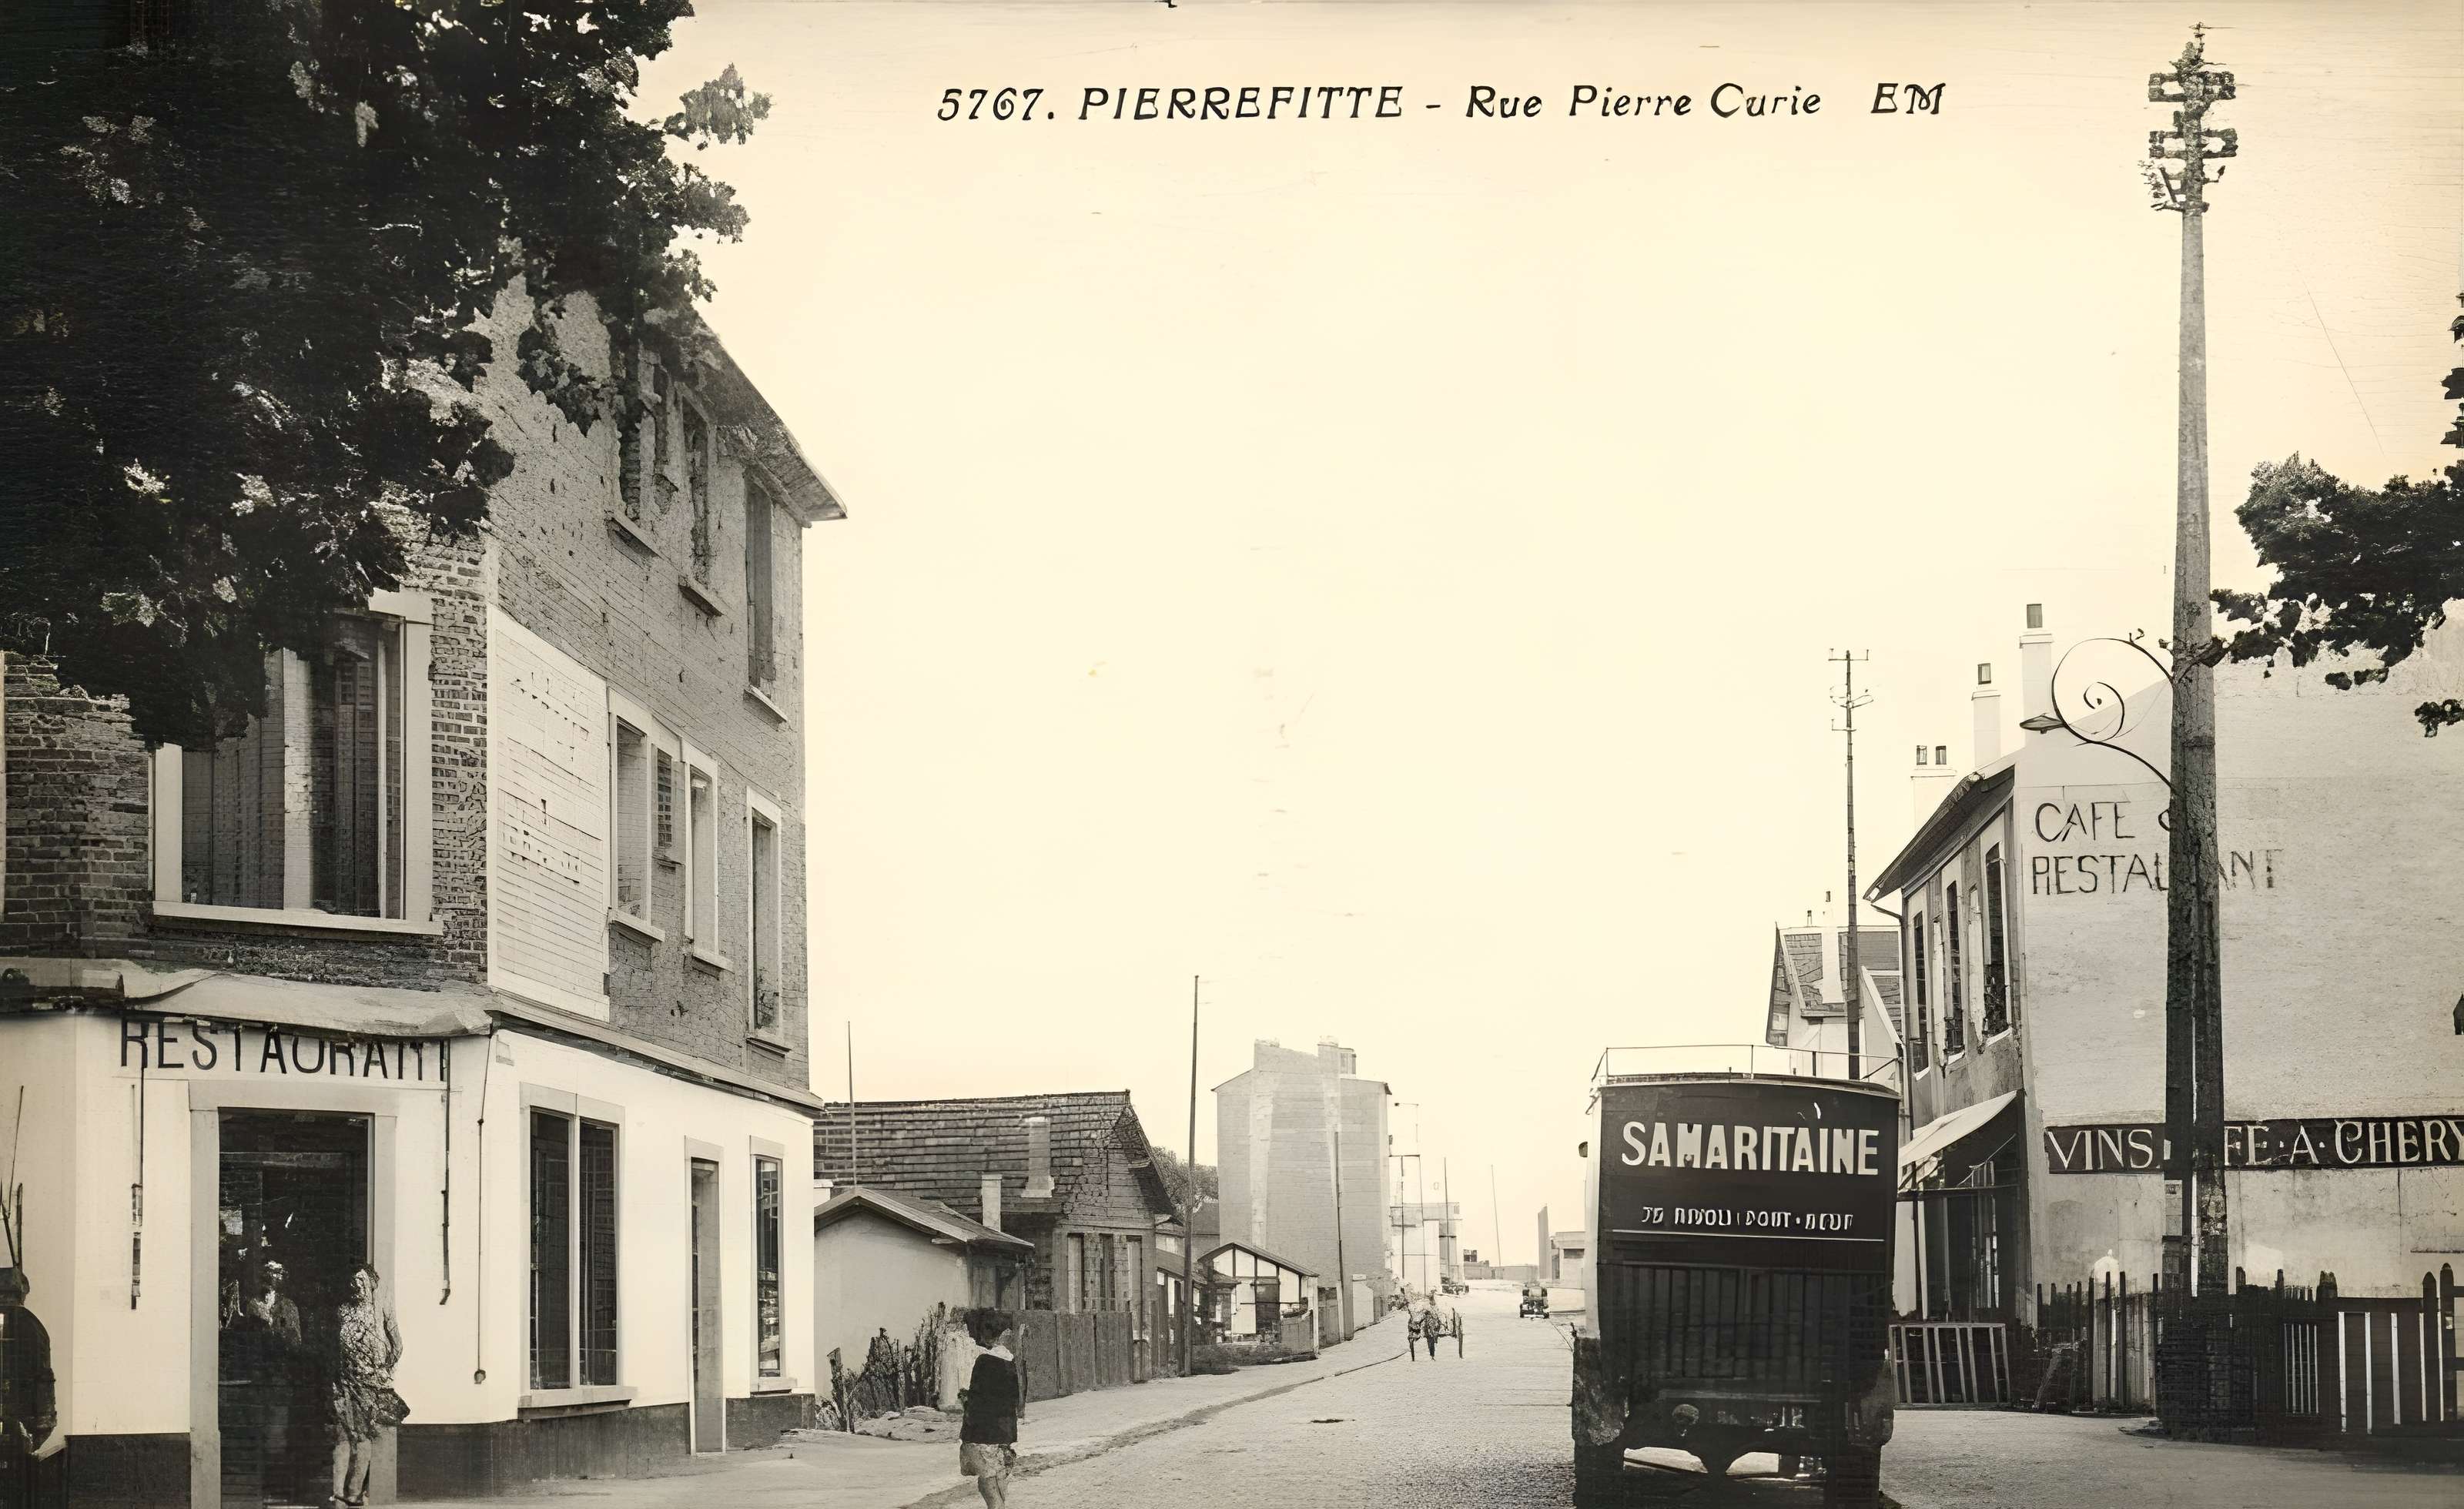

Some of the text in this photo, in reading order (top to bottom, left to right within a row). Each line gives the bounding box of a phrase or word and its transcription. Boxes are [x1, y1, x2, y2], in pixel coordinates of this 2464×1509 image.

[2032, 849, 2284, 895] RESTAUNT
[1622, 1121, 1880, 1176] SAMARITAINE
[2047, 1129, 2153, 1170] VINS
